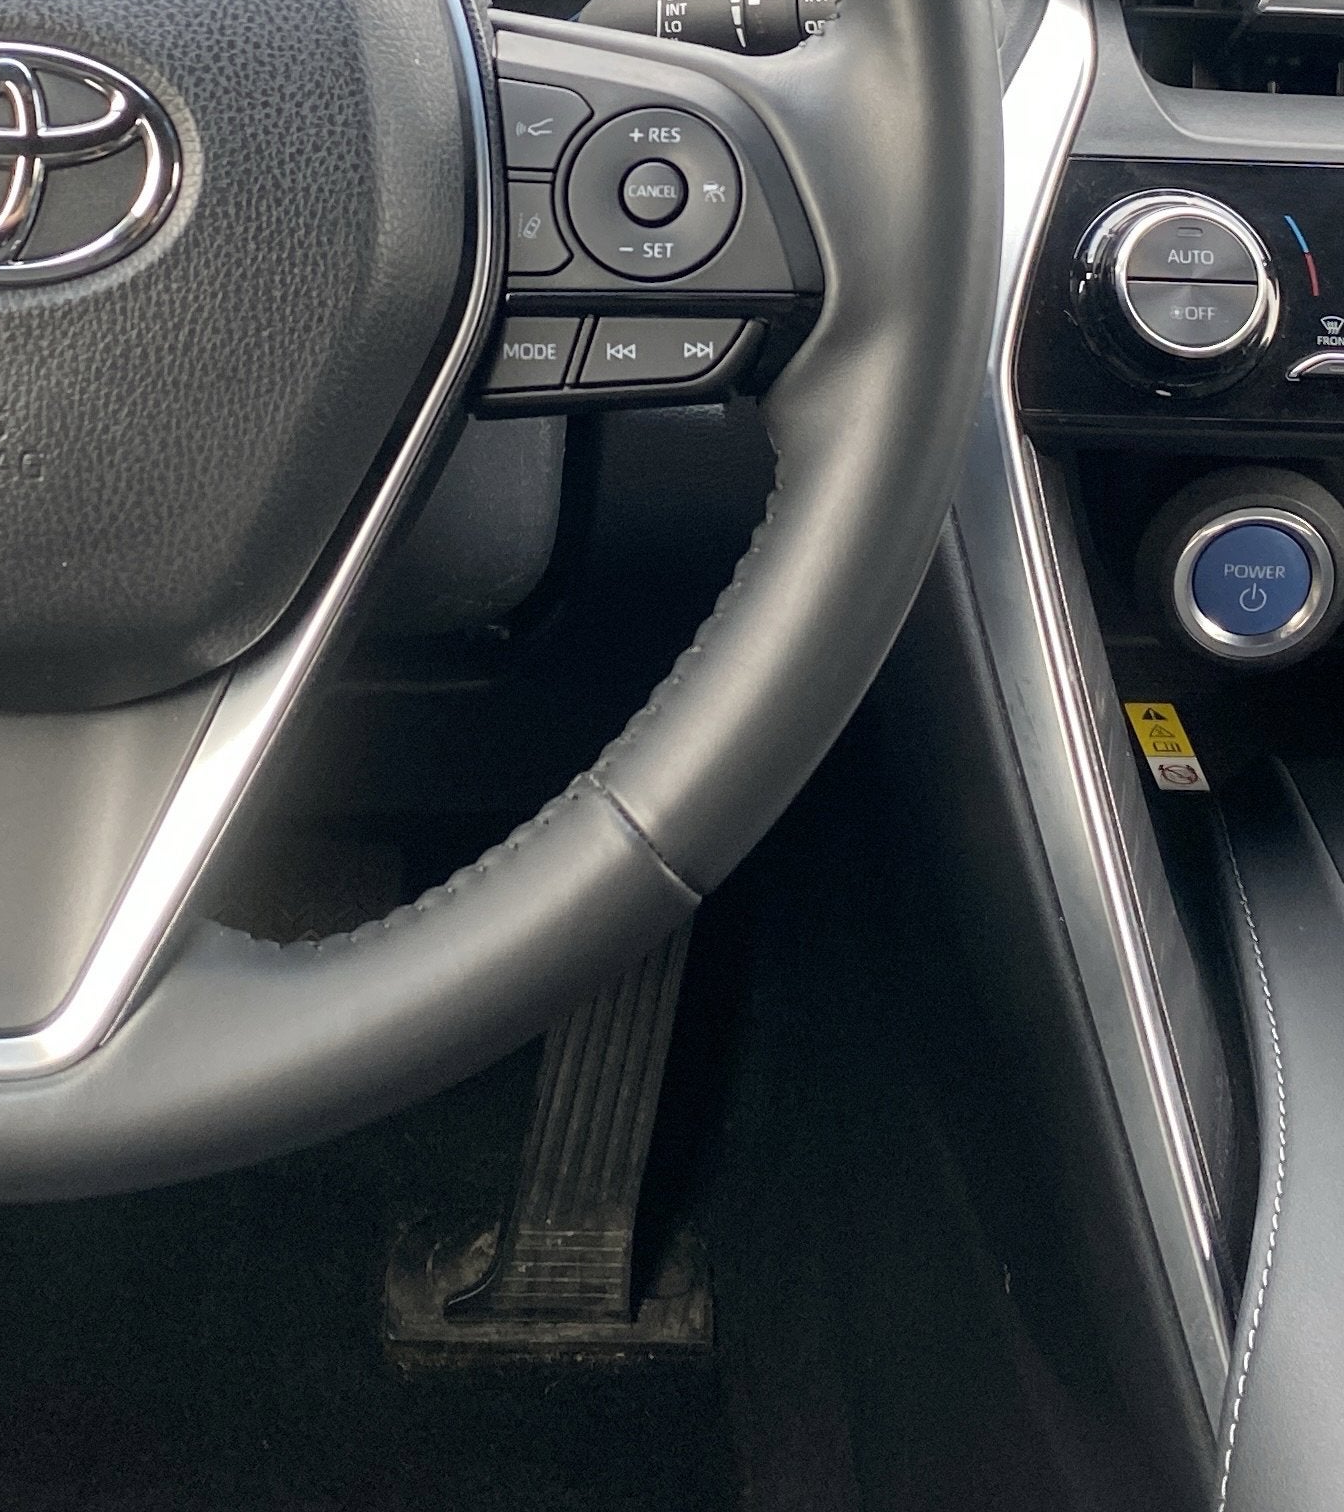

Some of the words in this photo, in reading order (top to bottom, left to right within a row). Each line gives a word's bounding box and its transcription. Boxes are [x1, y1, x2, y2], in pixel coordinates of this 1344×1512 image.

[664, 3, 688, 16] INT
[663, 20, 682, 33] LO
[648, 128, 682, 143] RES
[627, 184, 678, 199] CANCEL
[642, 243, 674, 259] SET
[1167, 248, 1215, 266] AUTO
[1184, 305, 1216, 322] OFF
[503, 343, 557, 361] MODE
[1223, 563, 1286, 580] POWER
